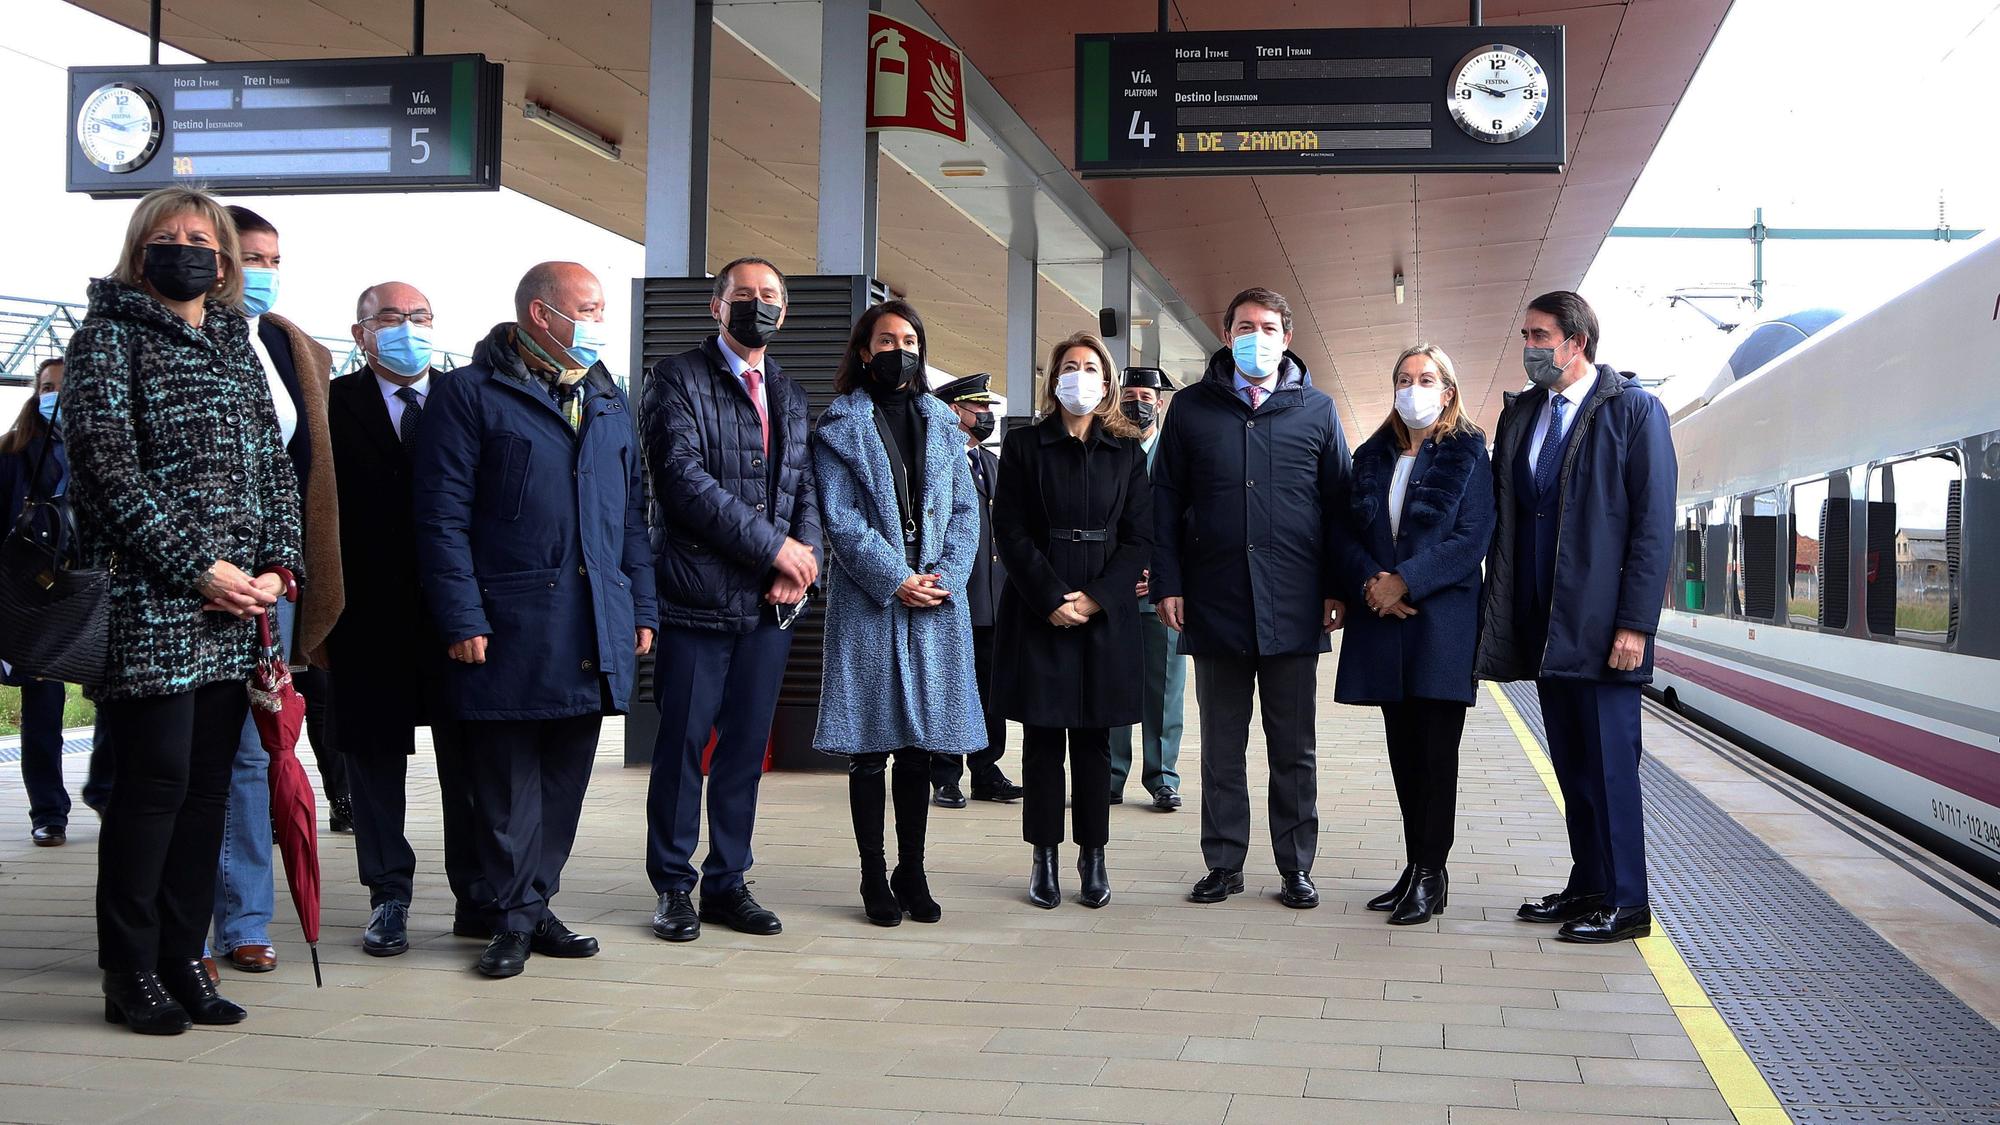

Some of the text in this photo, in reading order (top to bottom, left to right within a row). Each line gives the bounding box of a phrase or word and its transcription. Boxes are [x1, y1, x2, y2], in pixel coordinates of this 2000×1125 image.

[1175, 48, 1201, 58] Hora
[1256, 46, 1282, 57] Tren
[1489, 59, 1506, 70] 12
[174, 78, 196, 87] Hora
[243, 75, 265, 86] Tren
[1124, 89, 1158, 97] PLATFORM
[1175, 91, 1211, 103] Destino
[1461, 89, 1472, 100] 9
[1523, 89, 1533, 100] 3
[115, 95, 129, 106] 12
[406, 107, 437, 116] PLATFORM
[92, 123, 101, 134] 9
[142, 122, 150, 133] 3
[173, 119, 203, 130] Destino
[1128, 110, 1156, 148] 4
[1492, 119, 1503, 130] 6
[411, 127, 430, 164] 5
[1197, 132, 1224, 151] DE
[1236, 131, 1318, 151] ZAMORA
[115, 150, 125, 161] 6
